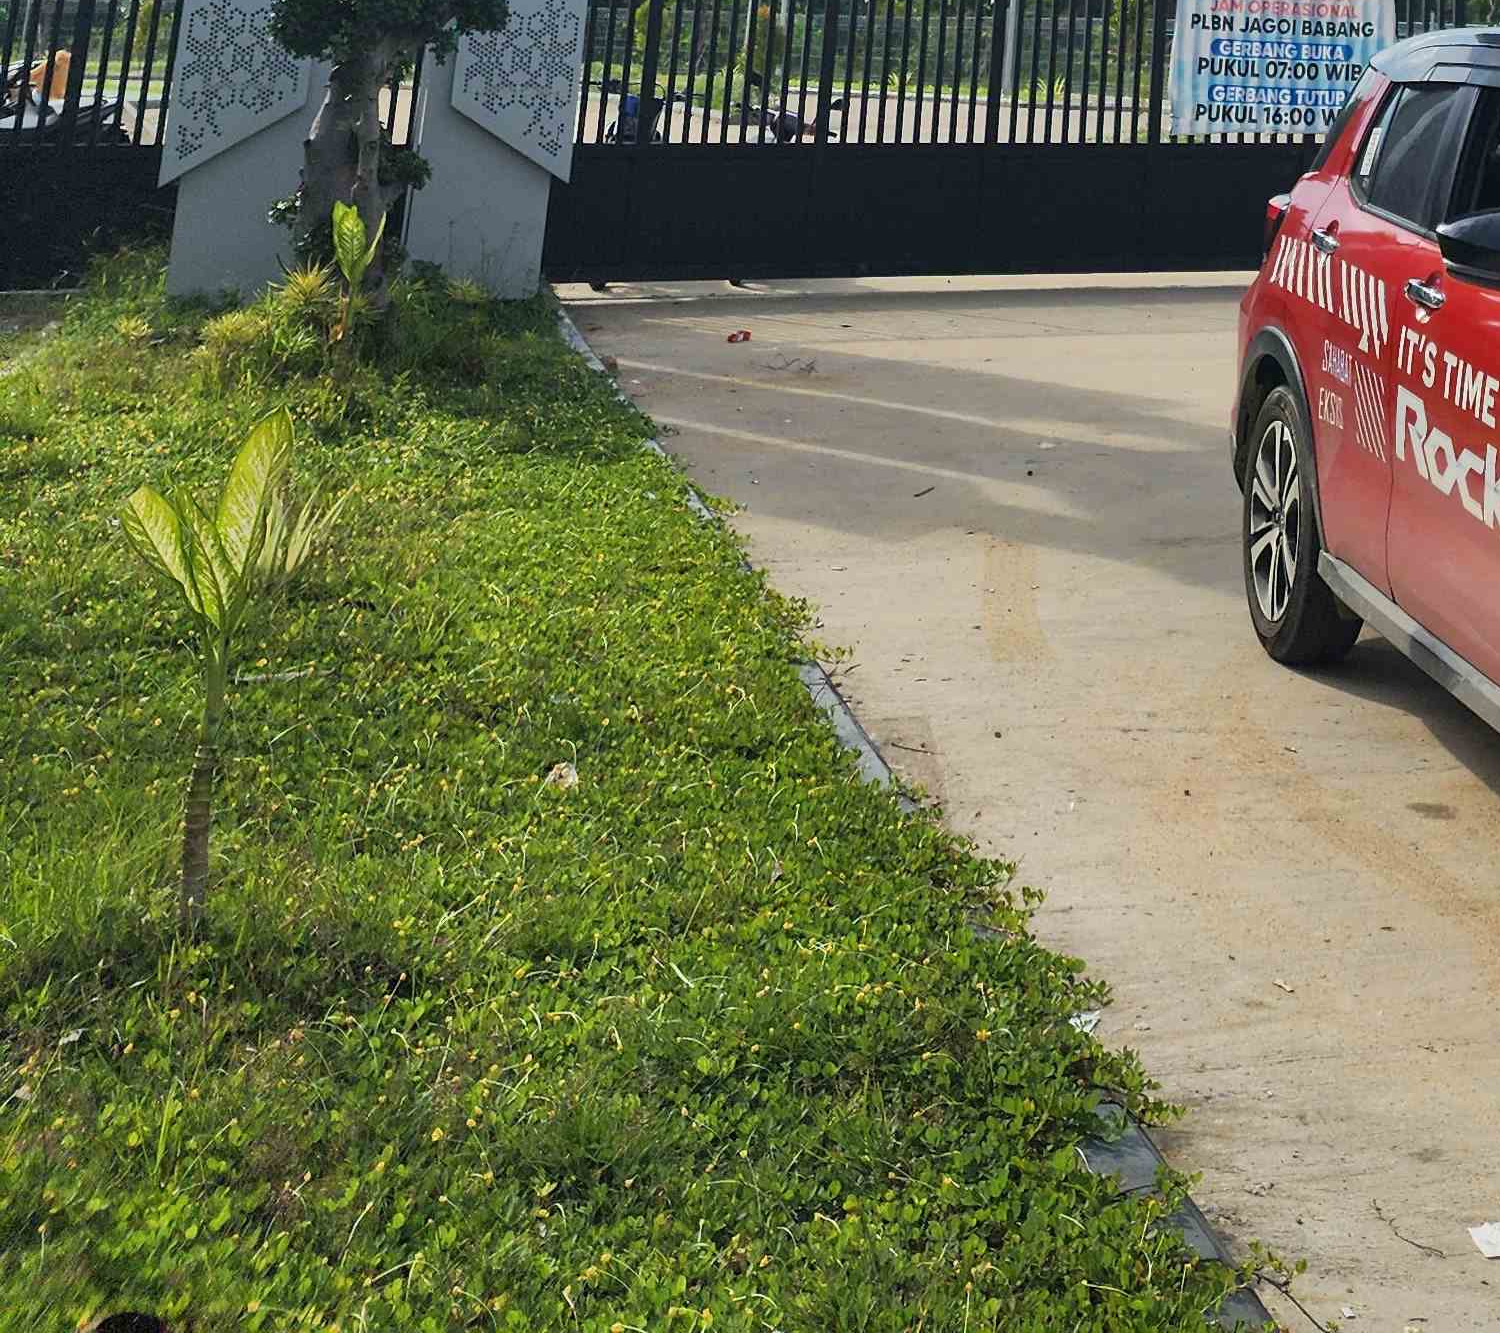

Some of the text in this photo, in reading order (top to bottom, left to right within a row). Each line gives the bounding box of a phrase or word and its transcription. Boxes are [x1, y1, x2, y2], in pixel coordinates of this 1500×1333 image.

[1247, 0, 1359, 18] OPERASIONAL
[1191, 13, 1374, 38] PLBN JAGOI BABANG
[1219, 42, 1344, 60] GERBANG BUKA
[1198, 57, 1363, 82] PUKUL 07:00 WIB
[1212, 85, 1346, 106] GERBANG TUTUP
[1195, 103, 1258, 124] PUKUL
[1263, 106, 1316, 126] 16:00
[1397, 325, 1438, 388] IT'S
[1443, 349, 1499, 429] TIME
